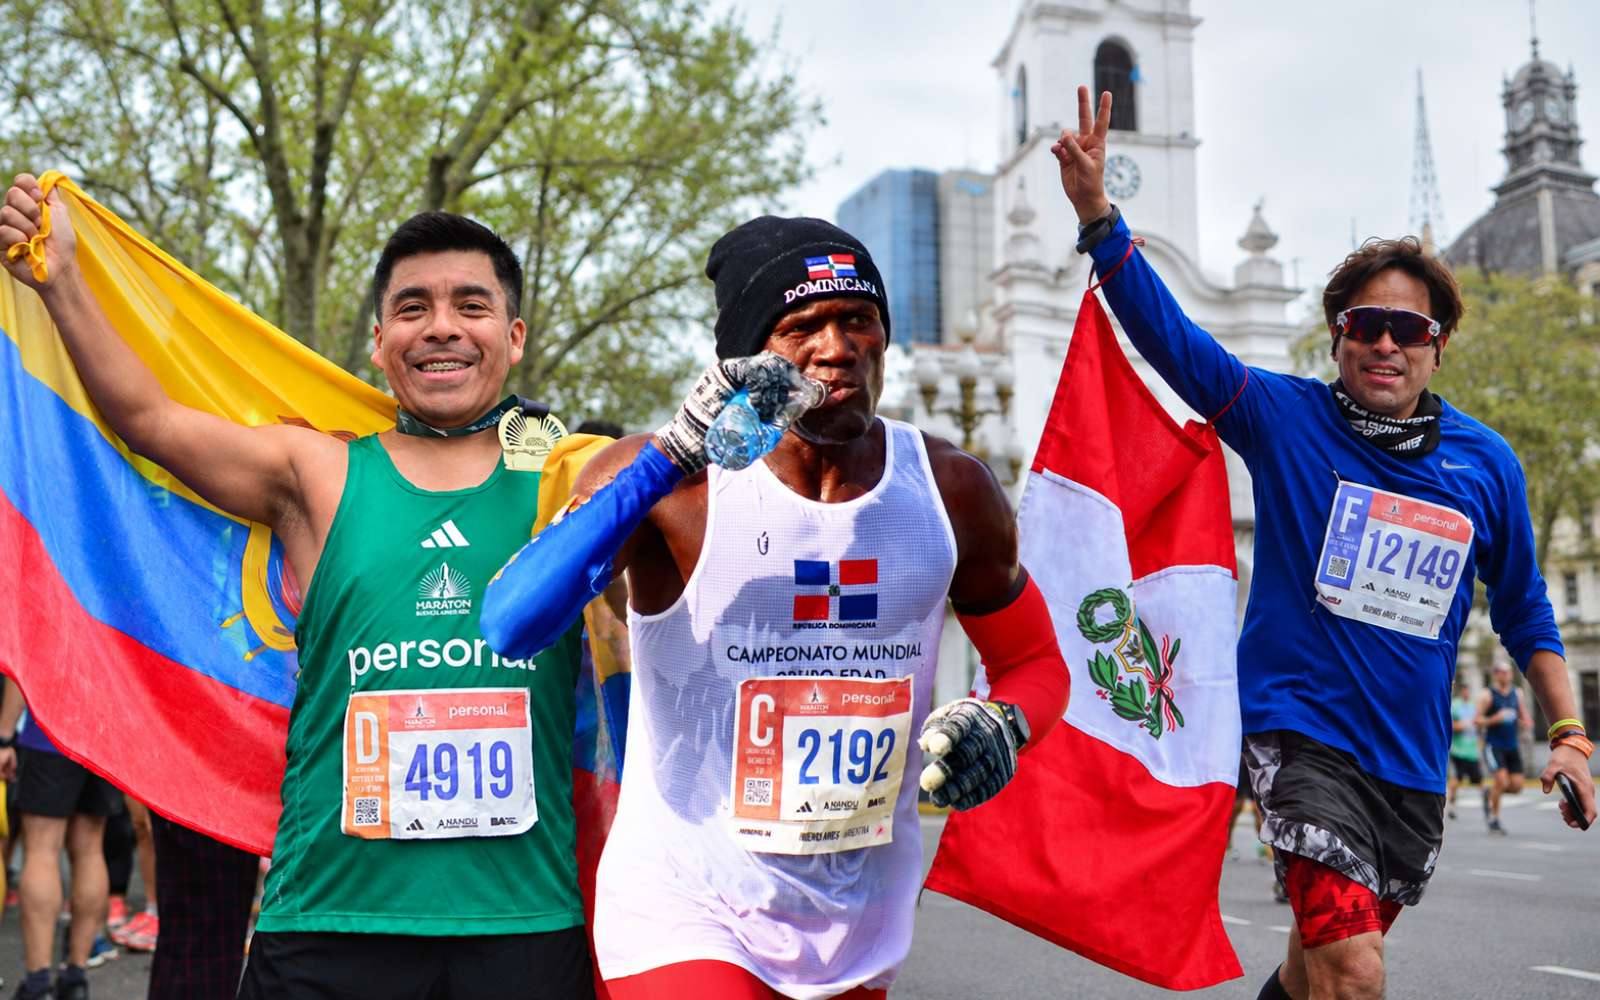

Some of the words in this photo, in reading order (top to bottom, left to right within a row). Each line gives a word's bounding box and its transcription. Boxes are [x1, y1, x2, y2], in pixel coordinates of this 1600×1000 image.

[784, 278, 879, 303] DOMINICANA
[1339, 495, 1363, 533] F
[1413, 512, 1460, 532] personal
[1366, 529, 1461, 590] 12149
[348, 637, 537, 686] person
[727, 645, 847, 664] CAMPEONATO
[852, 642, 922, 661] MUNDIAL
[449, 703, 508, 718] personal
[841, 691, 895, 706] personal
[355, 711, 380, 764] D
[750, 694, 775, 747] C
[404, 741, 513, 801] 4919
[797, 728, 896, 785] 2192
